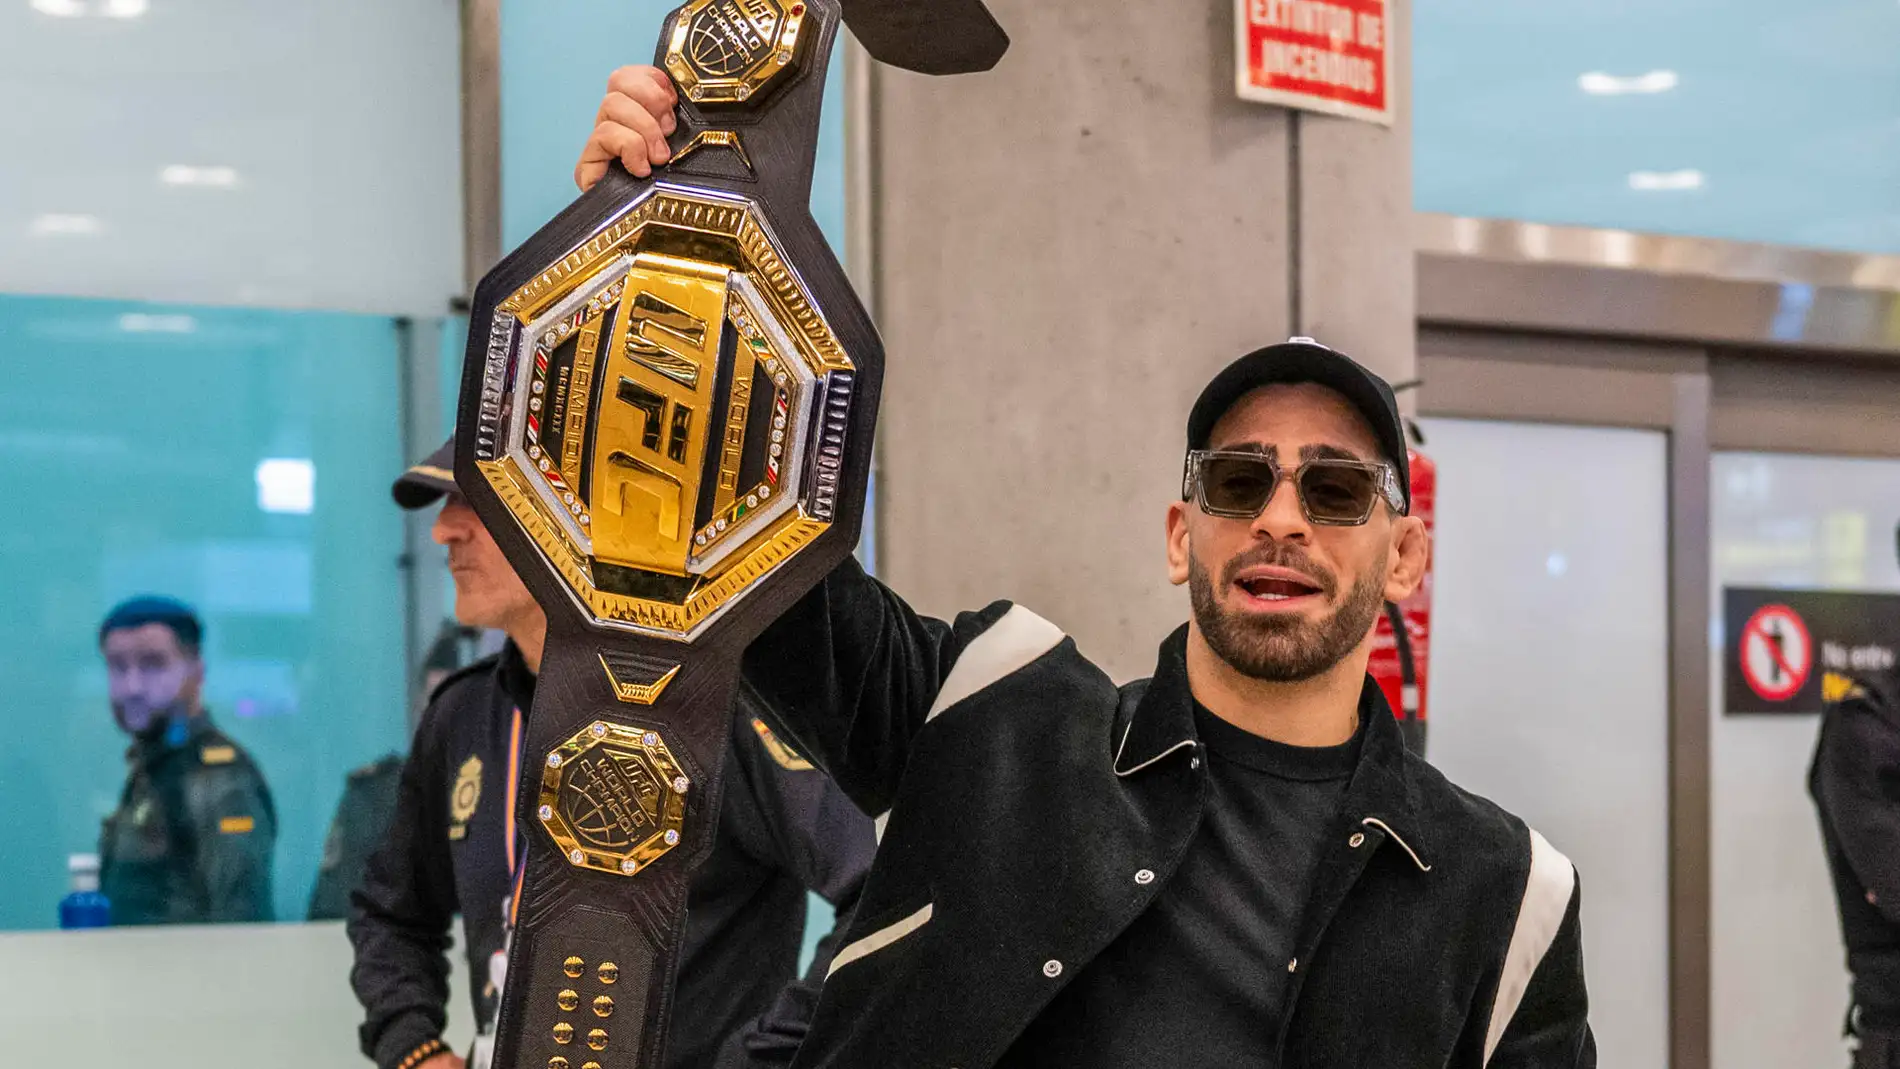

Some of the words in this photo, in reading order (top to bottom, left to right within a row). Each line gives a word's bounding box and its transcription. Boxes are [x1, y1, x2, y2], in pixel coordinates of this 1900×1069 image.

[707, 5, 754, 65] CHAMPION
[721, 1, 762, 51] WORLD
[1262, 39, 1374, 92] INCENDIOS
[561, 328, 597, 479] CHAMPION
[603, 290, 708, 541] UFC
[720, 376, 749, 490] WORLD
[580, 759, 639, 843] CHAMPION
[596, 758, 646, 826] WORLD
[622, 760, 655, 798] UFC
